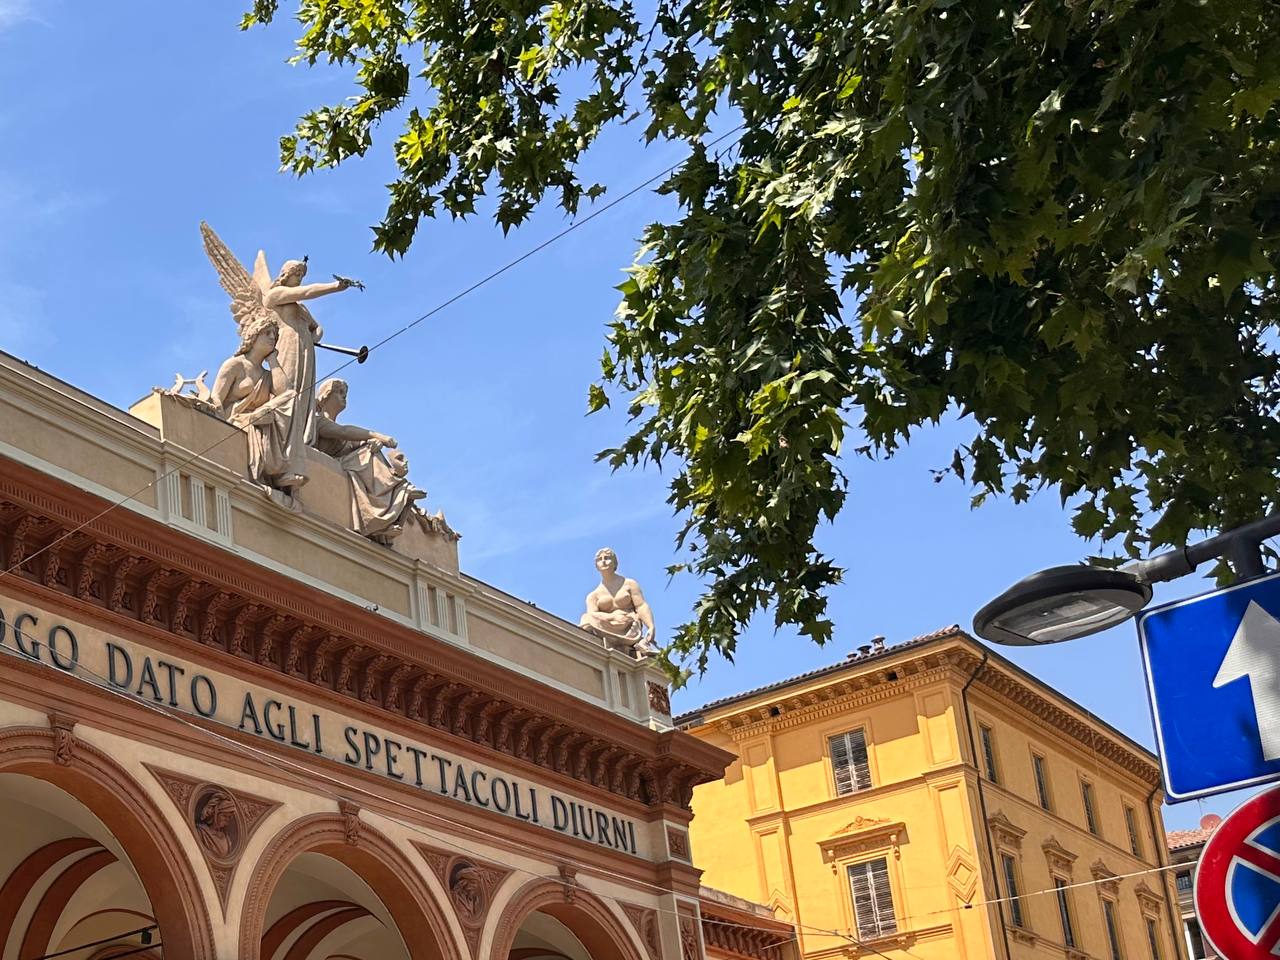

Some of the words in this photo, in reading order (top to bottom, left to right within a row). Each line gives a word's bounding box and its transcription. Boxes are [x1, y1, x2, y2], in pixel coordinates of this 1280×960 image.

[106, 642, 218, 717] DATO
[238, 691, 324, 753] AGLI
[344, 726, 540, 823] SPETTACOLI
[551, 795, 638, 855] DIURNI
